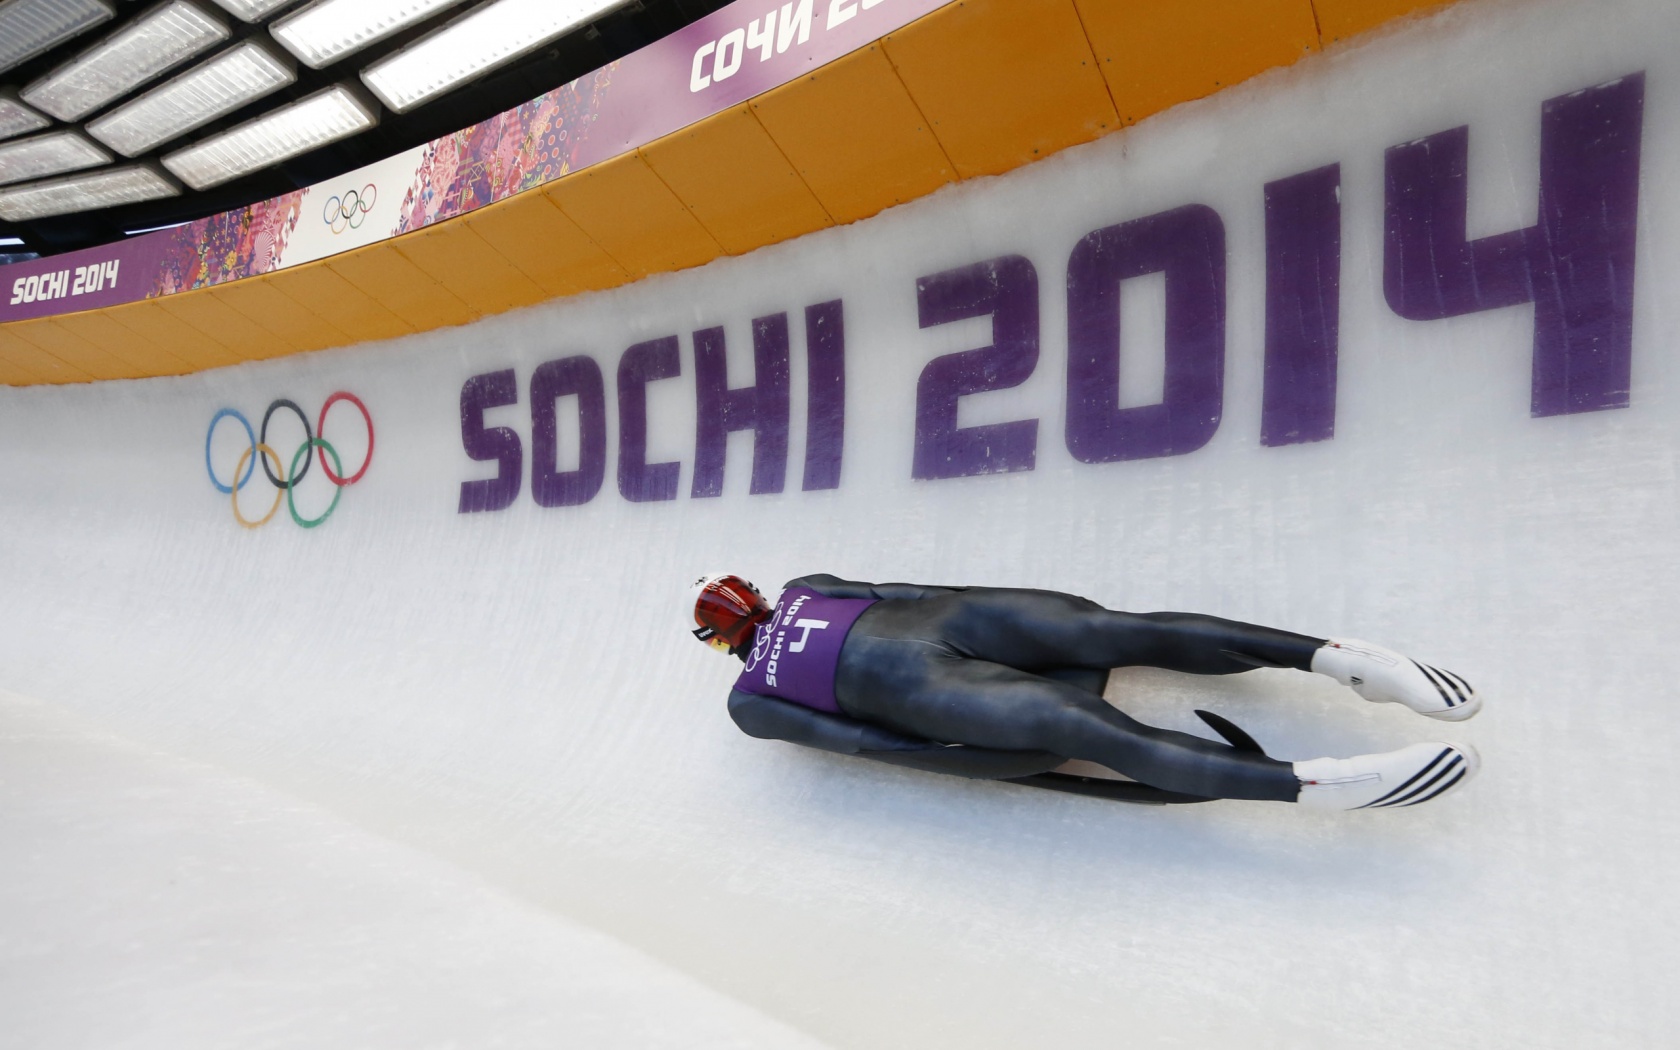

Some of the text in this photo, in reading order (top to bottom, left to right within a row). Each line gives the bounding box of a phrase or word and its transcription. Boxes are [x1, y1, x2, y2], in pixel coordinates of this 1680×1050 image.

[690, 0, 813, 93] СОЧИ
[10, 259, 120, 305] SOCHI 2014
[458, 70, 1645, 514] SOCHI 2014
[766, 595, 812, 687] SOCHI 2014
[788, 618, 830, 653] 4
